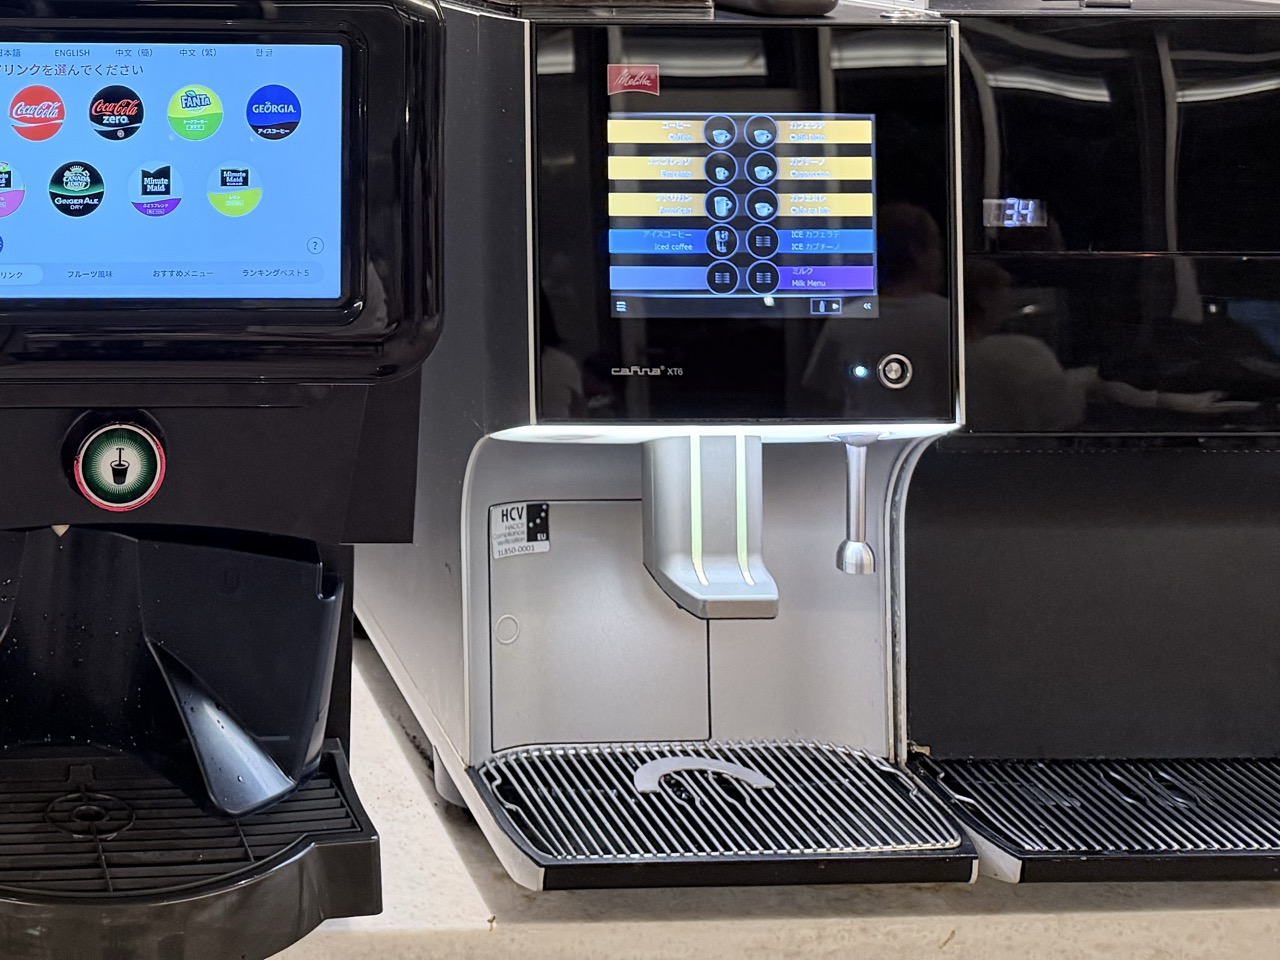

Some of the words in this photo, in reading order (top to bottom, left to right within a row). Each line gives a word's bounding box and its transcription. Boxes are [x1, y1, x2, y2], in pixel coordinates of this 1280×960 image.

[54, 49, 90, 57] ENGLISH
[614, 68, 653, 86] Melitta
[12, 101, 61, 118] Coca-Cola
[91, 99, 140, 115] Coca-Cola
[103, 115, 129, 124] zero
[147, 184, 166, 192] Maid
[642, 230, 692, 238] アイスコーヒー
[791, 243, 803, 251] ICE
[153, 269, 214, 278] おすすめメニュー
[792, 267, 813, 275] ミルク
[667, 368, 683, 376] XT6
[501, 506, 524, 523] HCV
[537, 532, 546, 540] EU
